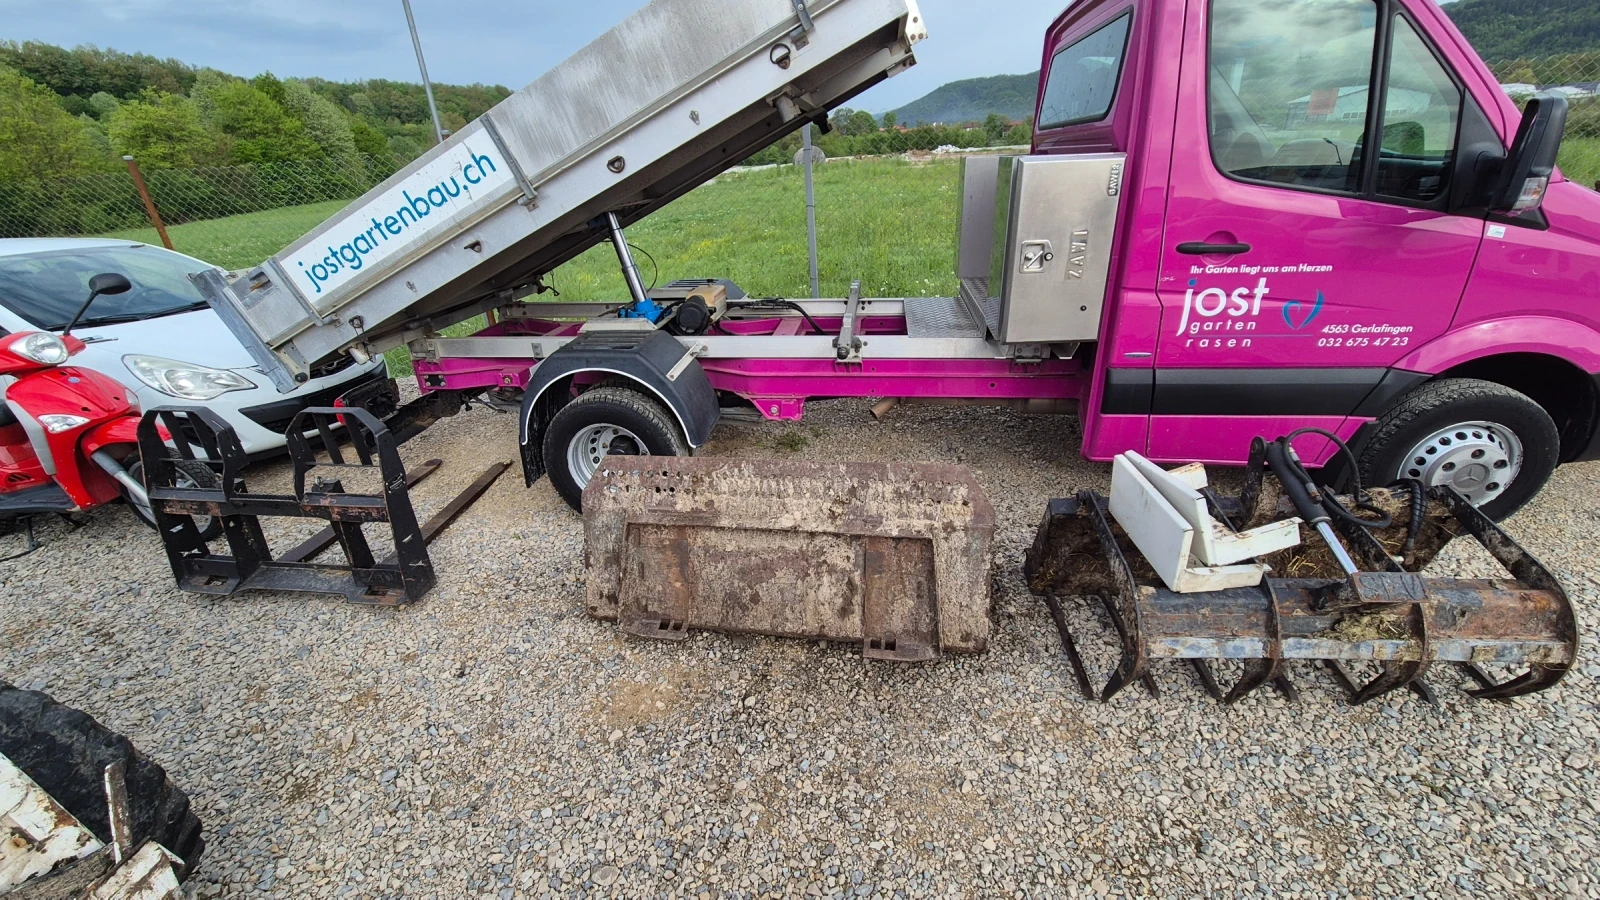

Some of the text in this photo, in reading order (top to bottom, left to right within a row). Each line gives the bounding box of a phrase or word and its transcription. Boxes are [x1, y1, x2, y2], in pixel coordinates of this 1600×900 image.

[298, 153, 497, 293] jostgartenbau.ch
[1190, 265, 1204, 274] Ihr
[1205, 264, 1238, 274] Garten
[1240, 264, 1261, 275] liegt
[1299, 263, 1333, 272] Herzen
[1175, 277, 1270, 337] jost
[1189, 319, 1257, 335] garten
[1321, 323, 1413, 335] 4563 Gerlafingen
[1186, 337, 1252, 348] rasen
[1318, 337, 1409, 347] 032 675 47 23
